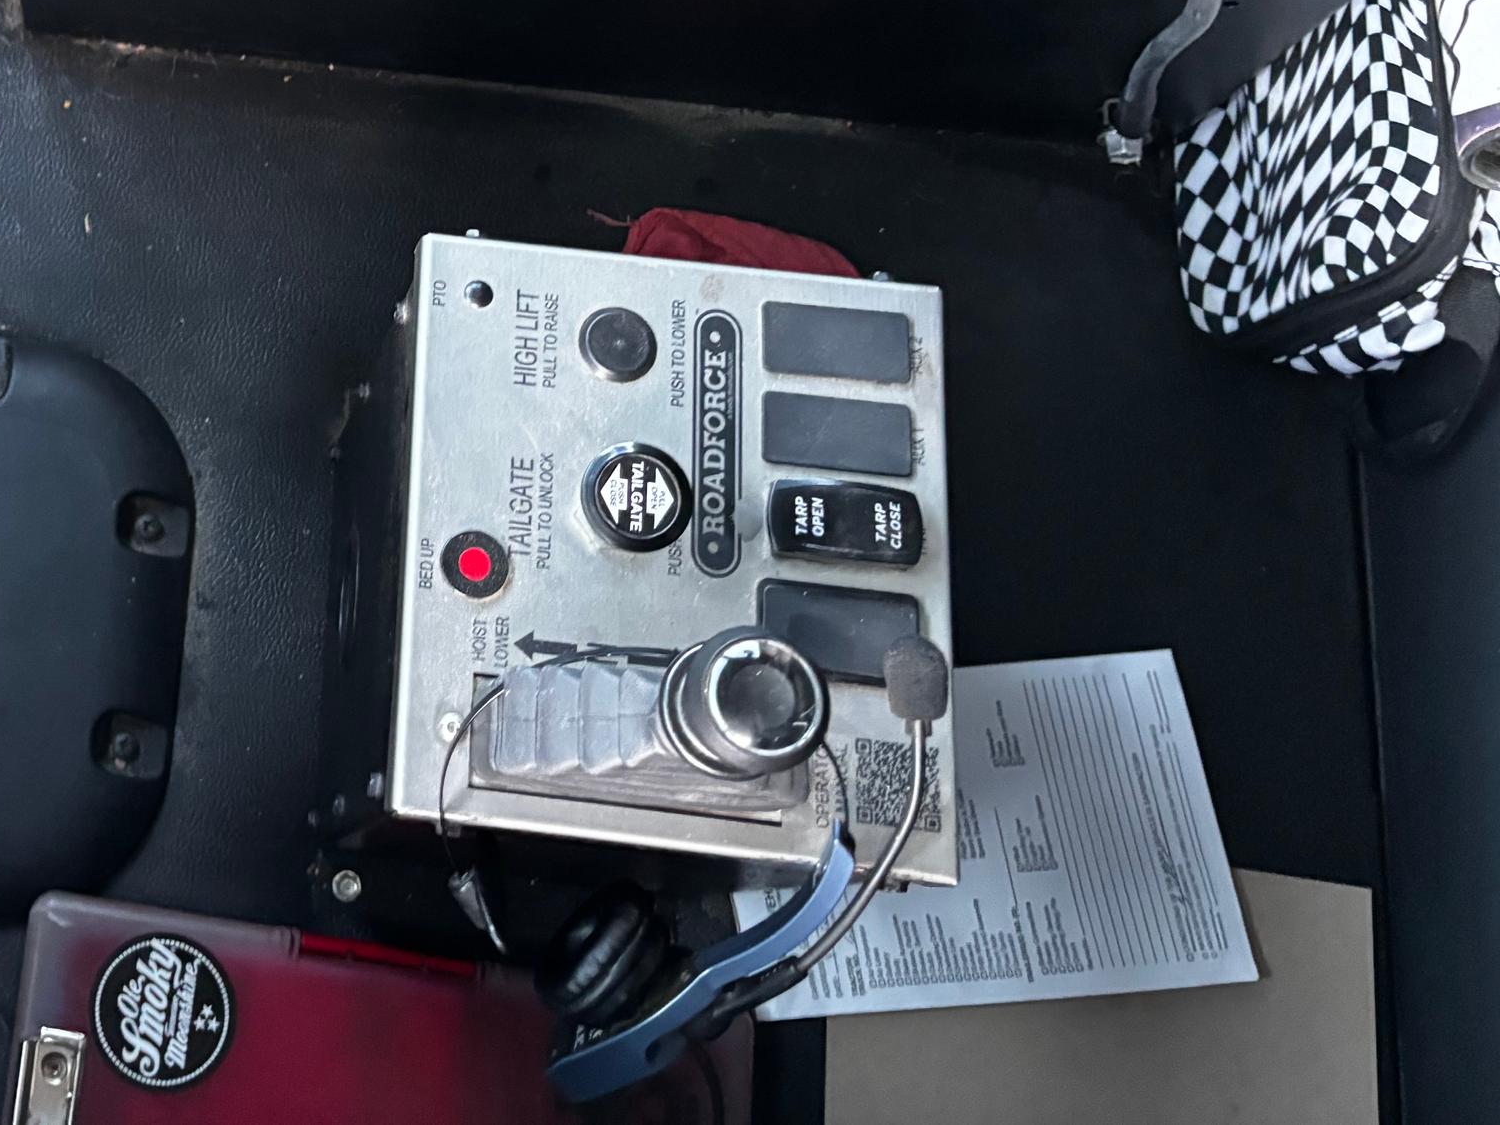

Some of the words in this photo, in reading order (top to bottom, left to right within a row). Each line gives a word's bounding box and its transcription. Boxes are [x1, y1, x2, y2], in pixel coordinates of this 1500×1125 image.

[432, 280, 447, 307] PTO
[515, 288, 540, 331] LIFT
[544, 292, 560, 331] RAISE
[543, 335, 558, 353] TO
[671, 299, 686, 347] LOWER
[513, 336, 538, 387] HIGH
[542, 357, 557, 388] PULL
[672, 349, 686, 366] TO
[670, 368, 685, 408] PUSH
[702, 348, 727, 537] ROADFORCE
[539, 452, 555, 507] UNLOCK
[629, 461, 645, 532] TAILGATE
[507, 455, 535, 558] TAILGATE
[538, 512, 553, 529] TO
[795, 496, 808, 536] TARP
[812, 497, 825, 537] OPEN
[875, 503, 887, 543] TARP
[889, 501, 902, 550] CLOSE
[421, 538, 435, 556] UP
[536, 534, 552, 569] PULL
[419, 560, 434, 590] BED
[472, 618, 488, 662] HOIST
[494, 615, 510, 668] LOWER
[814, 743, 830, 829] OPERATO
[117, 975, 147, 1019] Ole
[120, 937, 182, 1077] Smoky
[164, 958, 201, 1070] Moonshine
